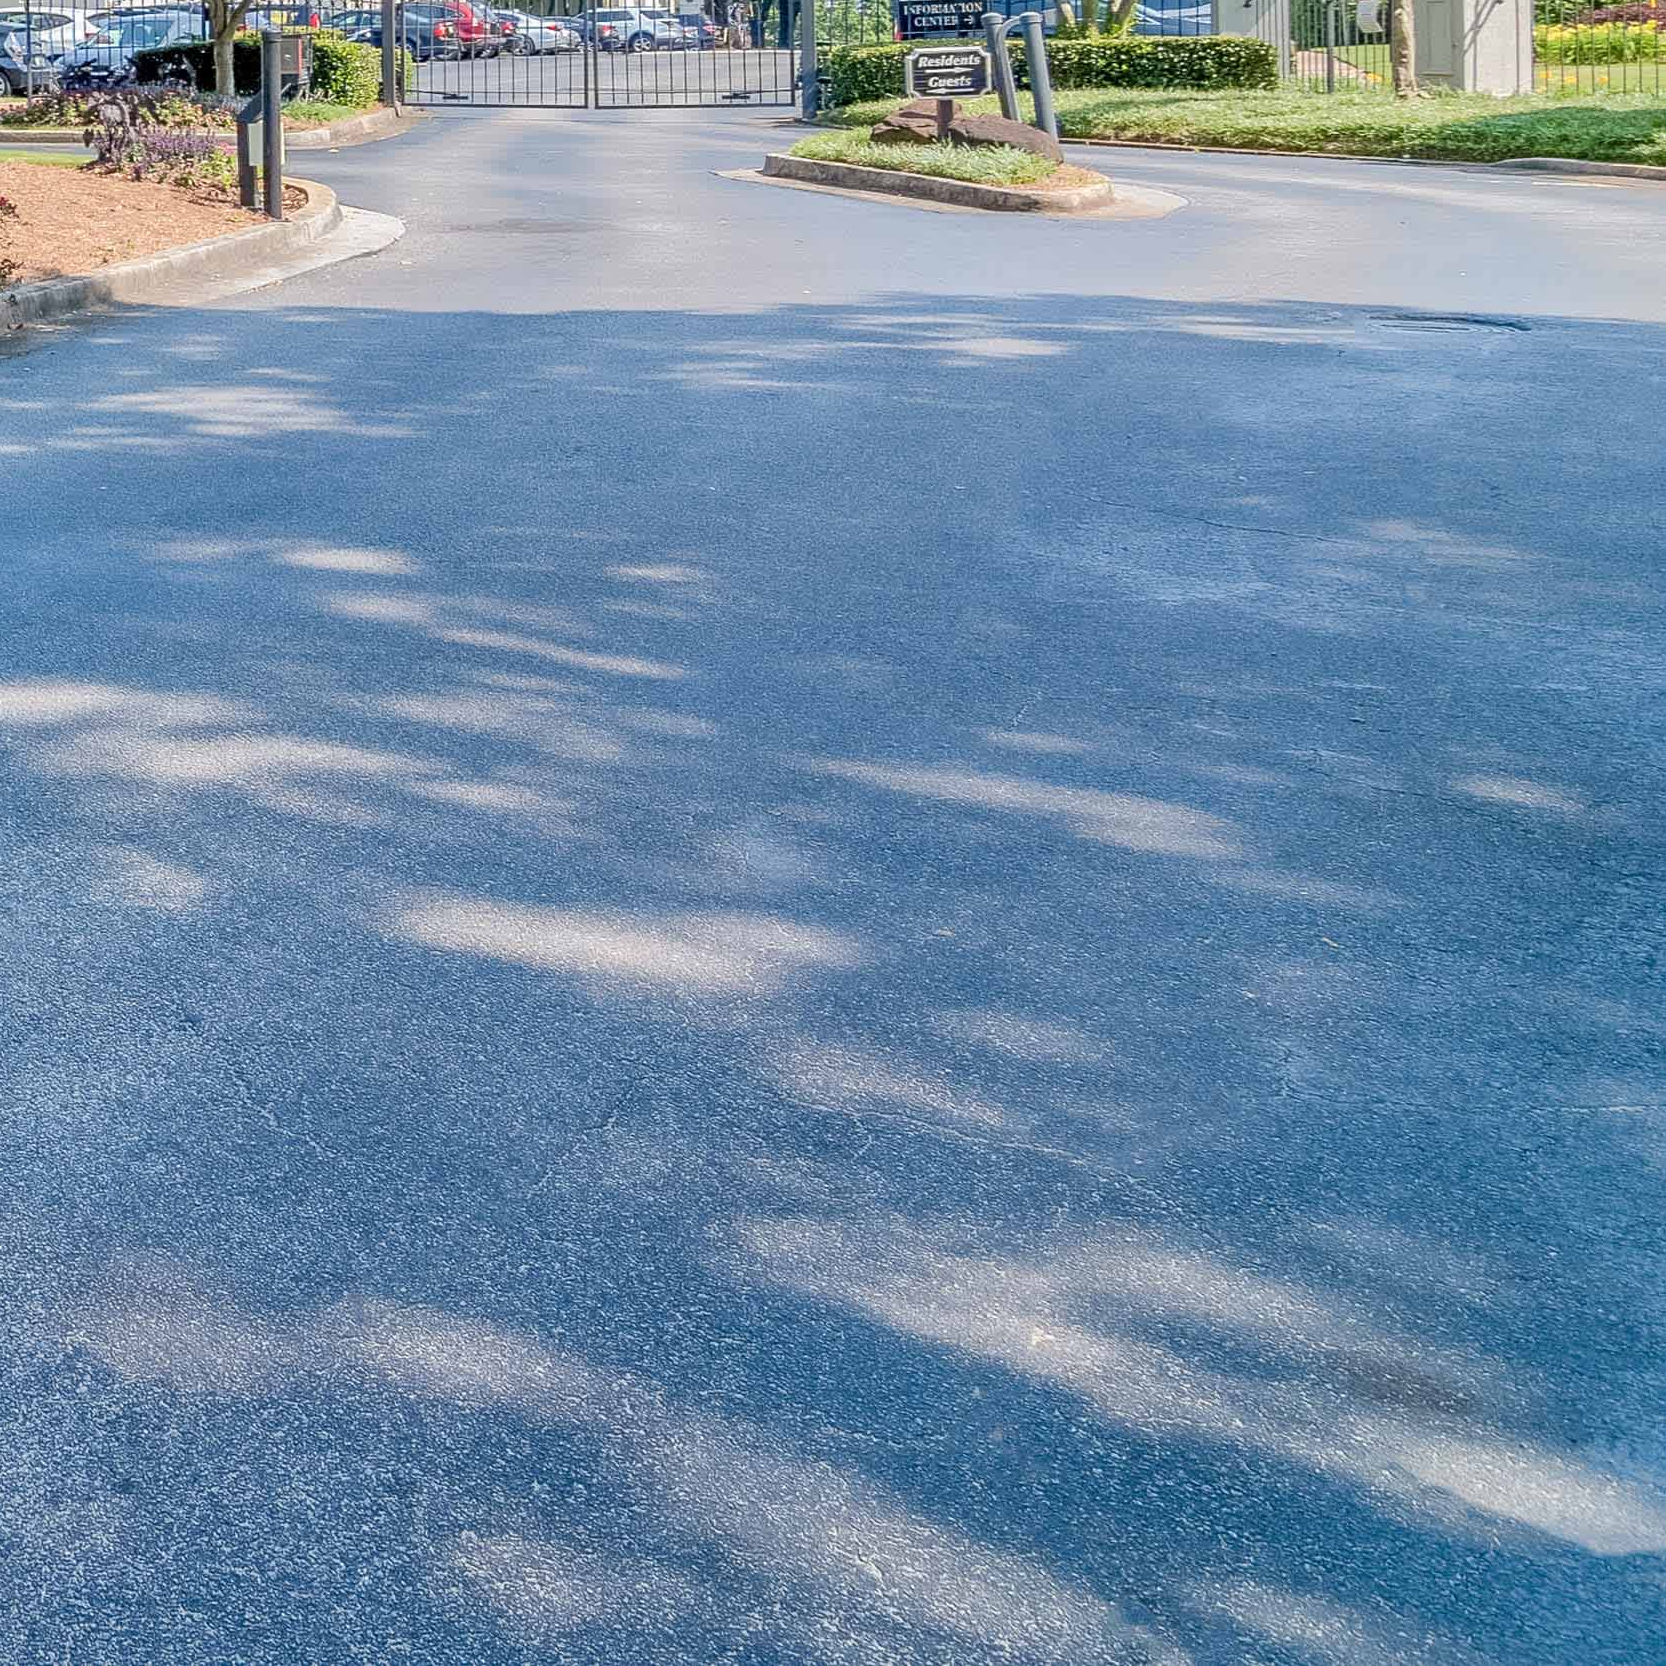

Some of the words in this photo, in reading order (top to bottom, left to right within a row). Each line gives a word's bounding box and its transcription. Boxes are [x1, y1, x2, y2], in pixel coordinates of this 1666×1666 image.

[914, 15, 958, 27] CENTER
[917, 54, 981, 68] Residents
[928, 75, 972, 87] Guests
